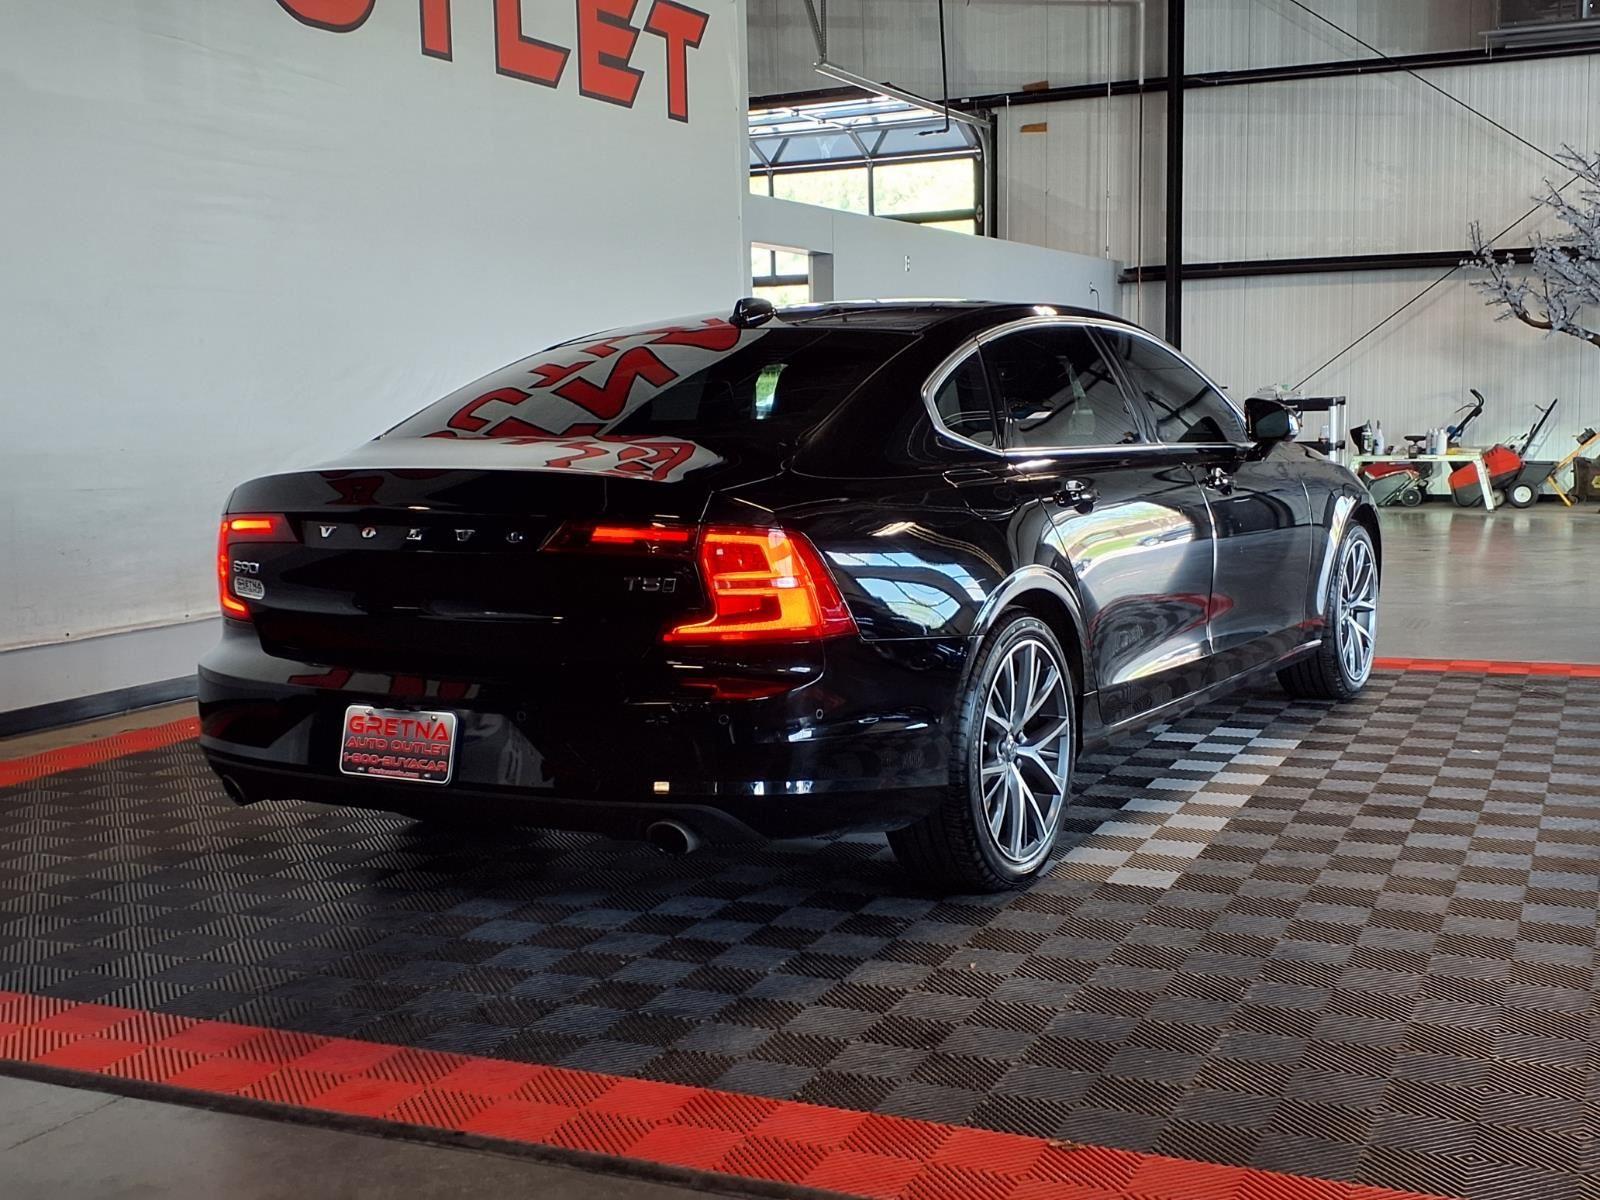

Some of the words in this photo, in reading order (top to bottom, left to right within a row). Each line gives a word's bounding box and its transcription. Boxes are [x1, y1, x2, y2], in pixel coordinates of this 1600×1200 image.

[275, 0, 710, 124] LET
[320, 525, 523, 544] VOLVO
[349, 715, 449, 740] GRETNA
[346, 736, 387, 749] AUTO
[391, 740, 450, 755] OUTLET
[344, 752, 448, 771] 1-800-BUYACAR
